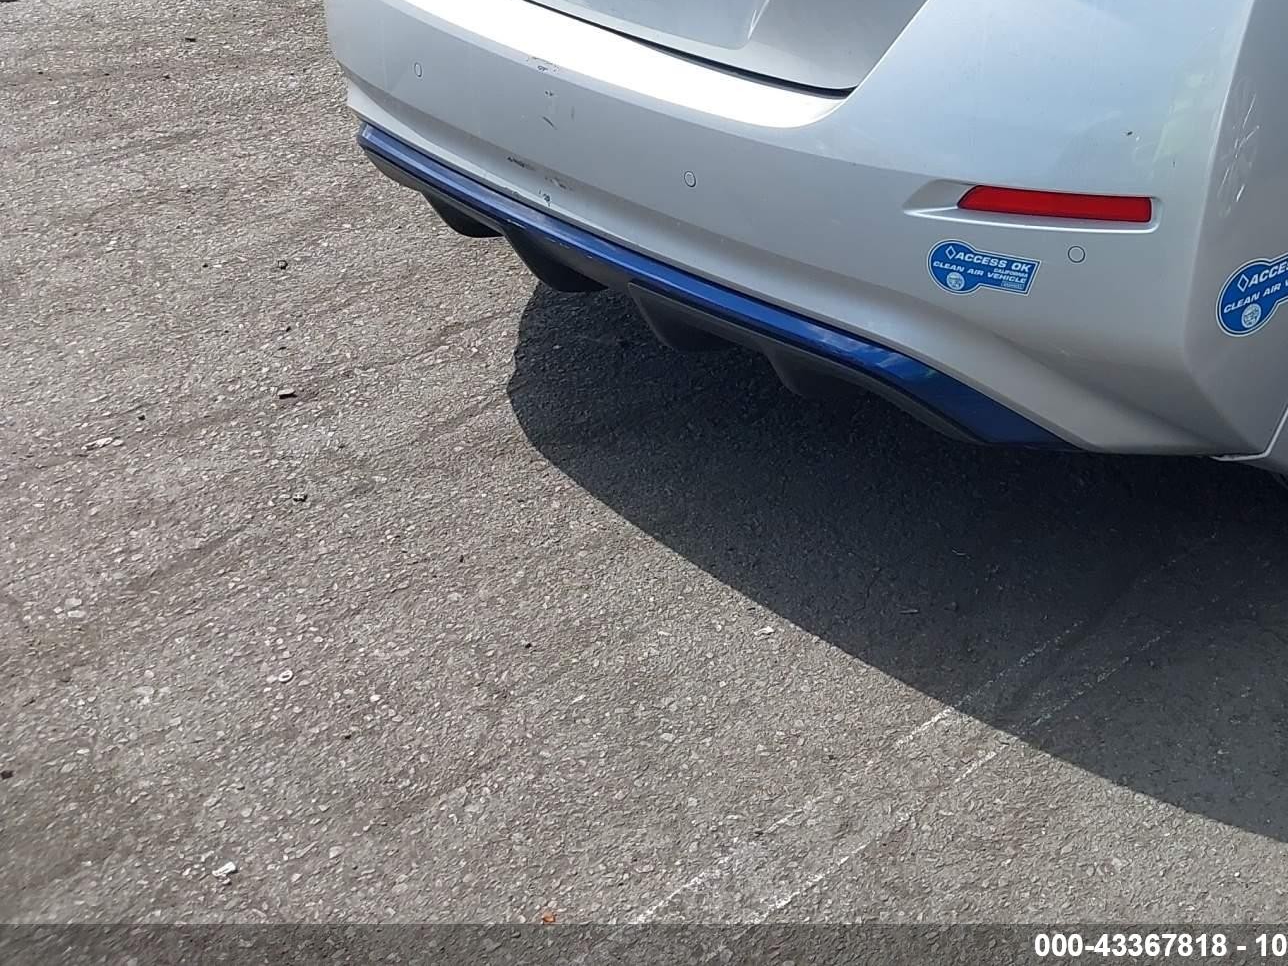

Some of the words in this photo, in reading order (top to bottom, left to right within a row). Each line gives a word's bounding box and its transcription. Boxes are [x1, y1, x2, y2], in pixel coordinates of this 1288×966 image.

[933, 260, 966, 273] CLEAN
[967, 268, 985, 277] AIR
[987, 272, 1028, 284] VEHICLE
[955, 252, 1008, 268] ACCESS
[1011, 262, 1032, 272] OK
[1223, 291, 1261, 314] CLEAN
[1263, 282, 1282, 298] AIR
